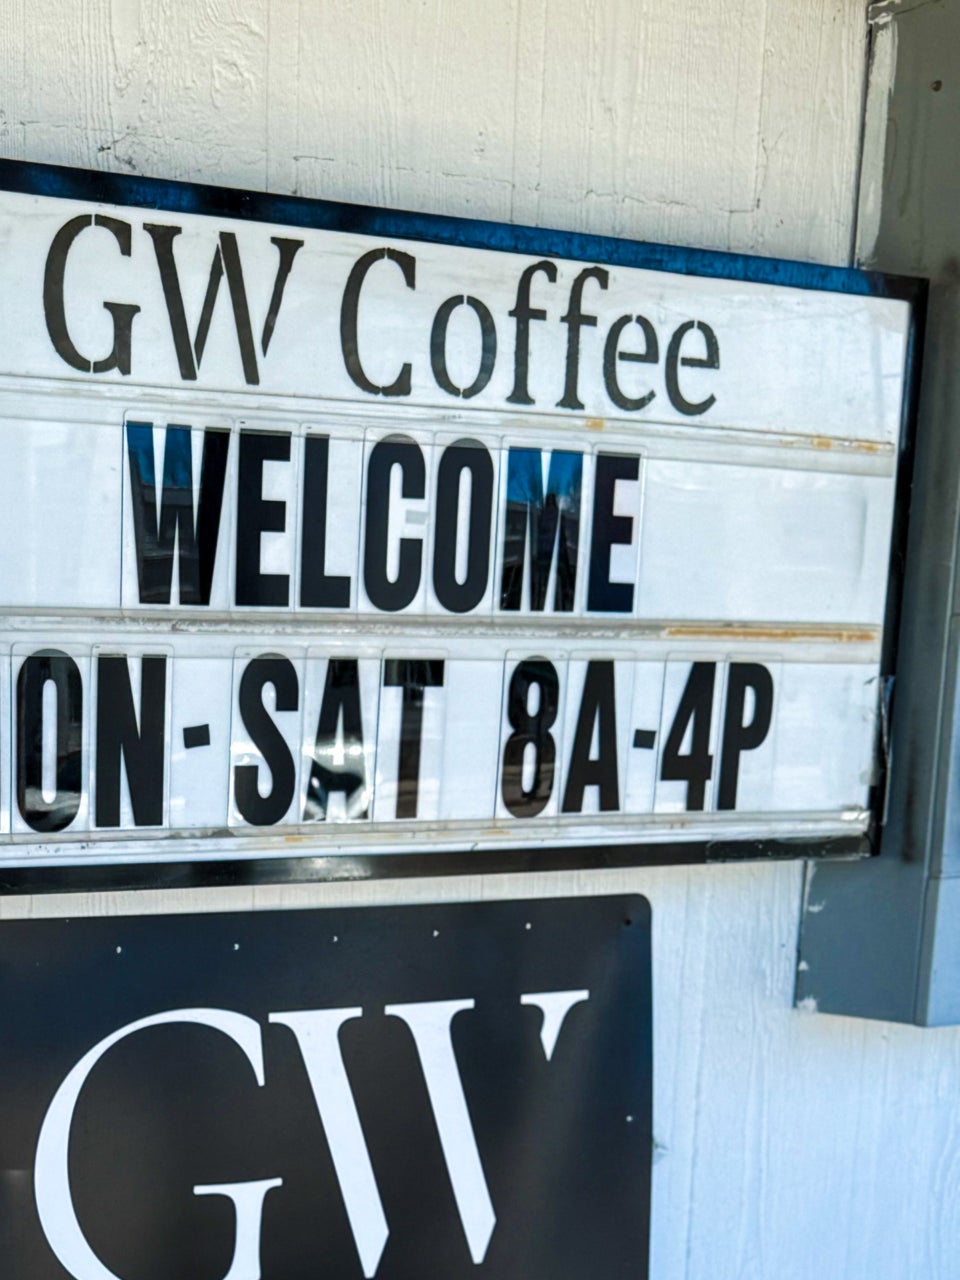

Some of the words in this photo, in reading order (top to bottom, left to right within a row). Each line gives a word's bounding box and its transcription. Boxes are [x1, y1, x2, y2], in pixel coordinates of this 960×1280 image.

[42, 212, 305, 386] GW
[339, 247, 720, 416] Coffee
[125, 420, 641, 614] WELCOME
[501, 655, 774, 819] 8A-4P
